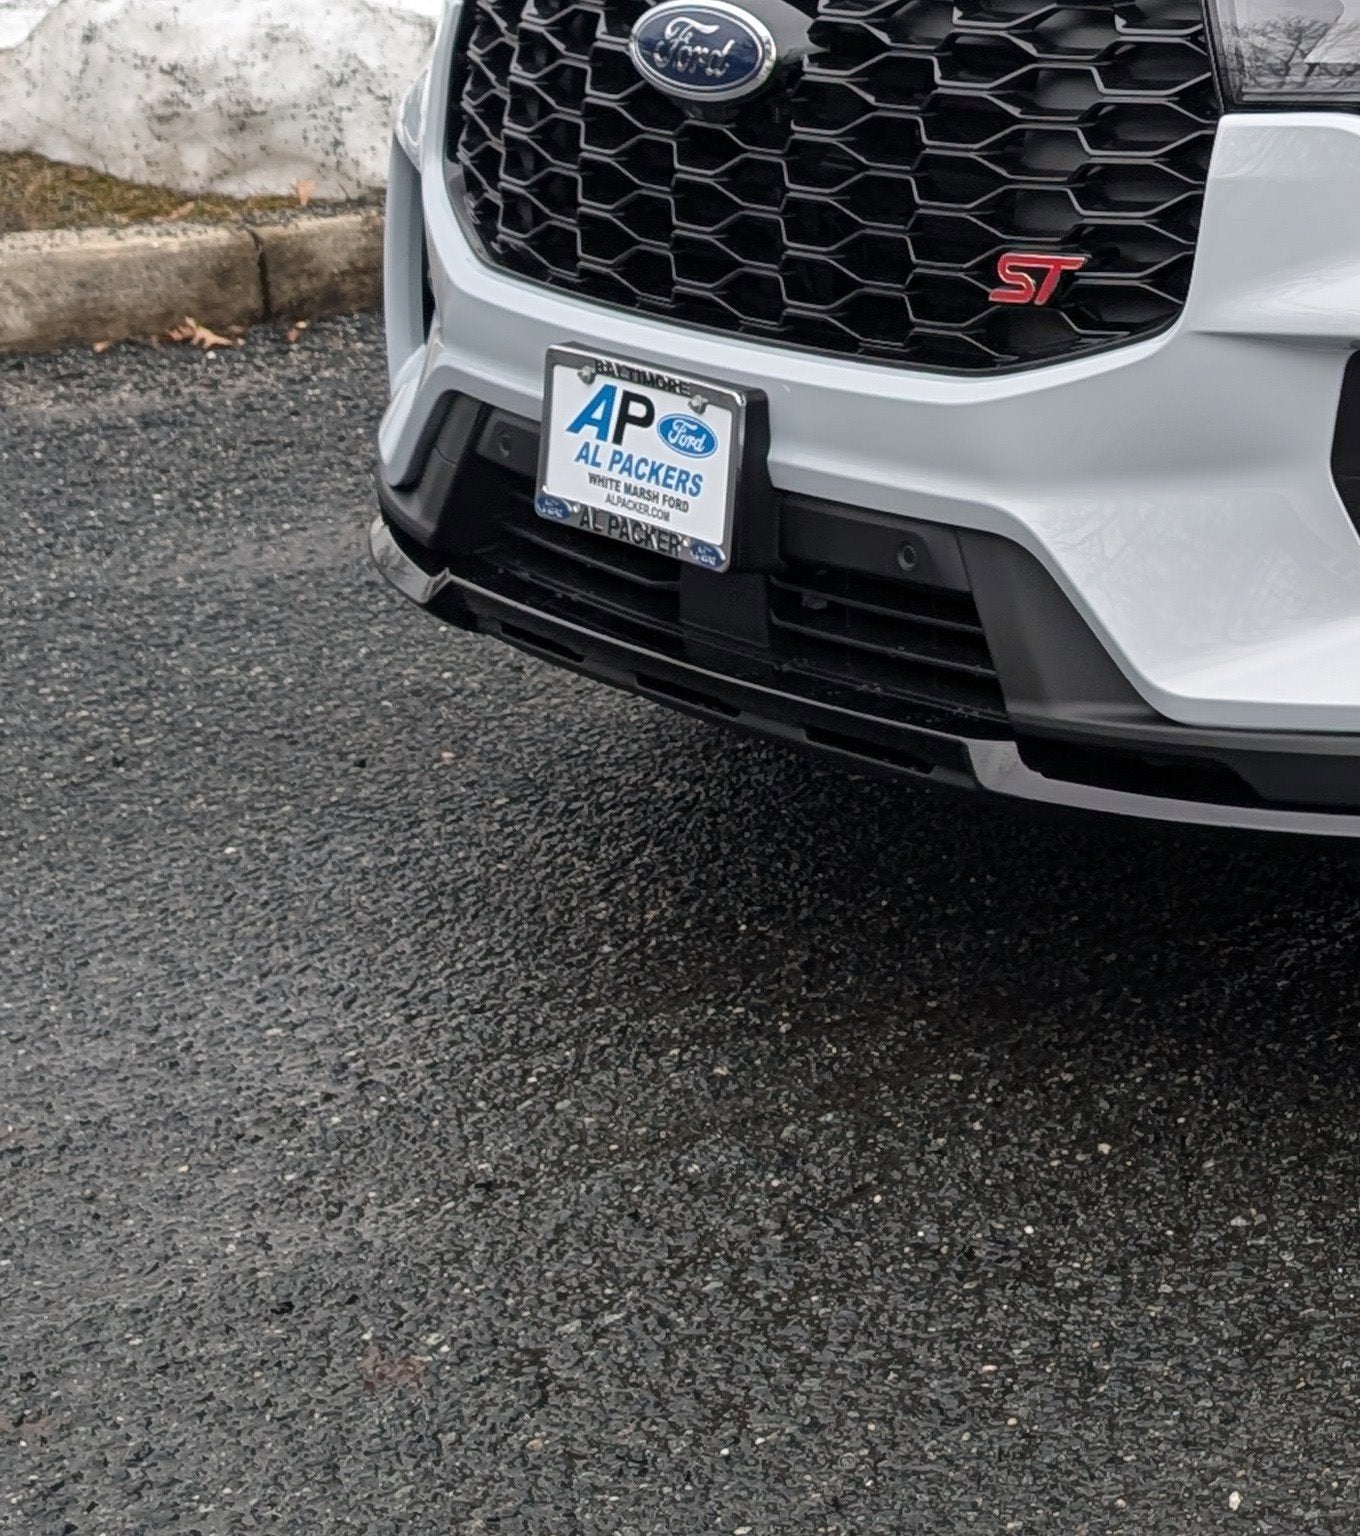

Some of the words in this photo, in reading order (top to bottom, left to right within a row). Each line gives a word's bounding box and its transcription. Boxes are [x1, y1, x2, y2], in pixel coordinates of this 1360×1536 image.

[653, 16, 736, 78] Ford
[988, 252, 1088, 305] ST
[595, 359, 691, 396] BALTIMORE
[566, 383, 656, 446] AP
[667, 419, 708, 451] Ford
[574, 440, 603, 470] AL
[606, 449, 704, 498] PACKERS
[588, 471, 622, 494] WHITE
[623, 480, 661, 505] MARSH
[662, 493, 690, 514] FORD
[579, 506, 604, 533] AL
[607, 513, 683, 558] PACKER
[604, 492, 671, 523] ALPACKER.COM
